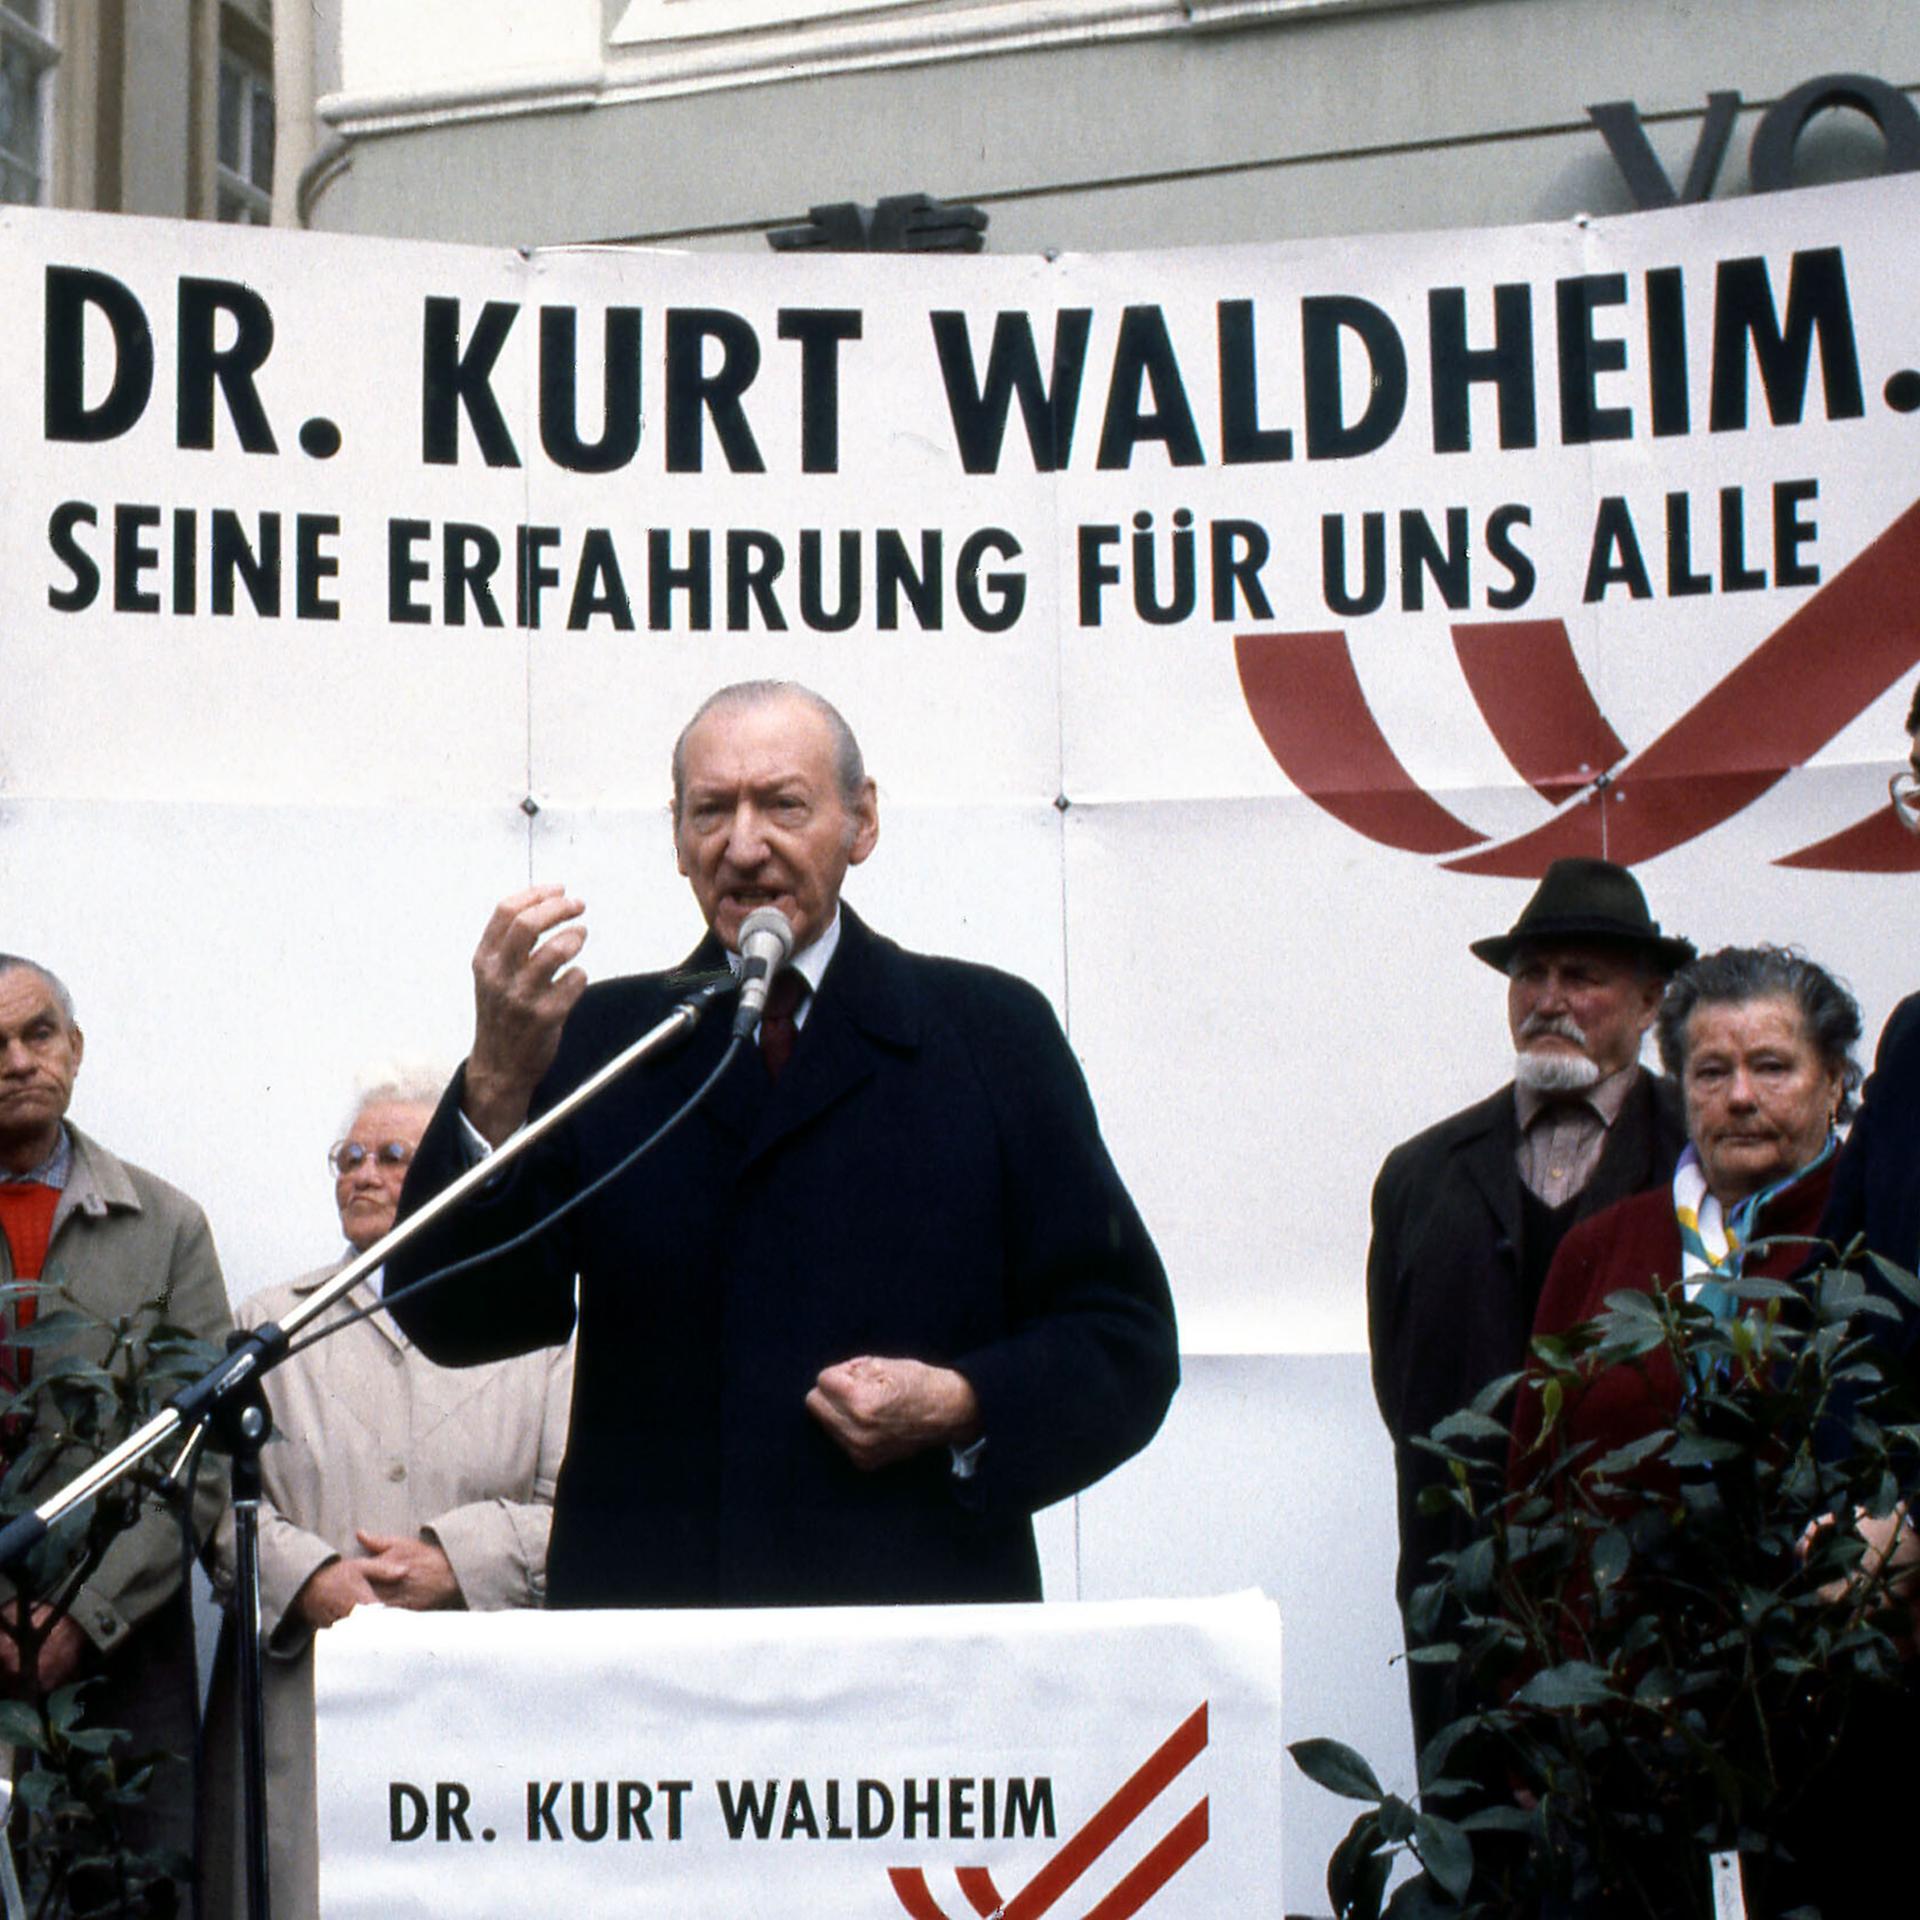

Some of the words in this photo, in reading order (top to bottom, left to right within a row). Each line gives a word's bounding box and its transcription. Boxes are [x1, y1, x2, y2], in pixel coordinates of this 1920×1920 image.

[45, 265, 342, 459] DR.
[423, 296, 863, 474] KURT
[929, 246, 1920, 474] WALDHEIM.
[48, 501, 340, 620] SEINE
[388, 519, 1027, 633] ERFAHRUNG
[1078, 508, 1275, 625] FÜR
[1322, 504, 1537, 617] UNS
[1583, 479, 1820, 604] ALLE
[389, 1782, 497, 1842] DR.
[526, 1780, 693, 1842] KURT
[717, 1777, 1057, 1840] WALDHEIM
